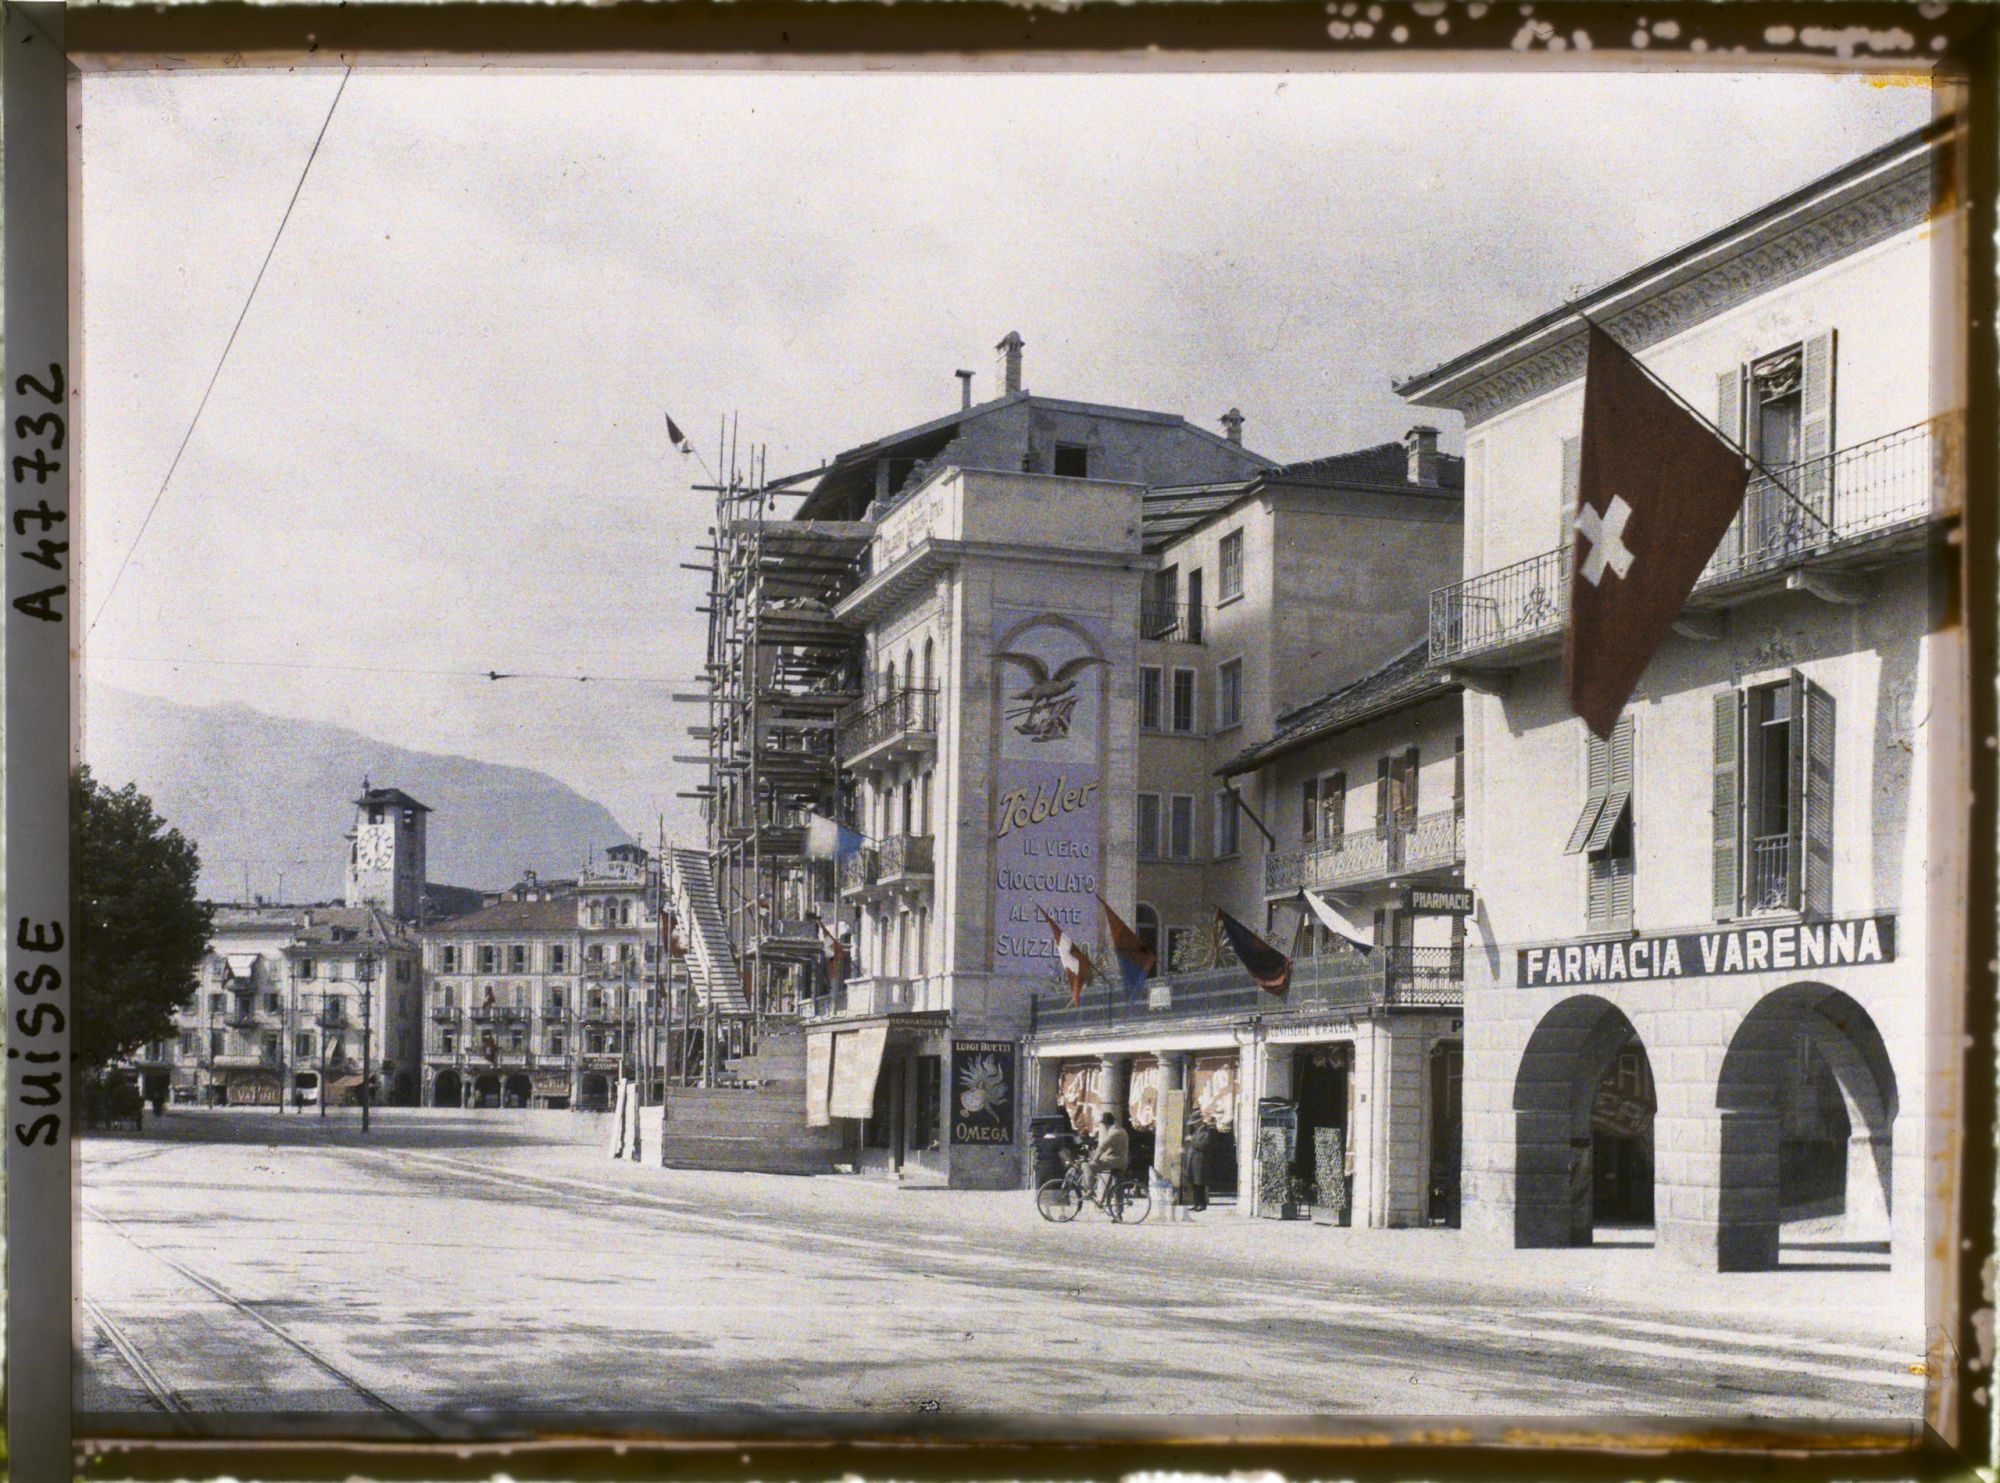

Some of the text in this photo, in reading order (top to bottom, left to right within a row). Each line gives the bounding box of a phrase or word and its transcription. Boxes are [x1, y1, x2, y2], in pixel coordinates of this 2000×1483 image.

[997, 774, 1098, 838] Tobler
[1023, 839, 1092, 858] IL VERO
[997, 864, 1096, 894] CIOCCOLATO
[1412, 892, 1471, 910] PHARMACIE
[1009, 905, 1082, 924] AL LATTE
[1525, 917, 1883, 986] FARMACIA VARENNA
[956, 1042, 1011, 1053] LUIGI BUETTI
[956, 1123, 1009, 1143] OMEGA
